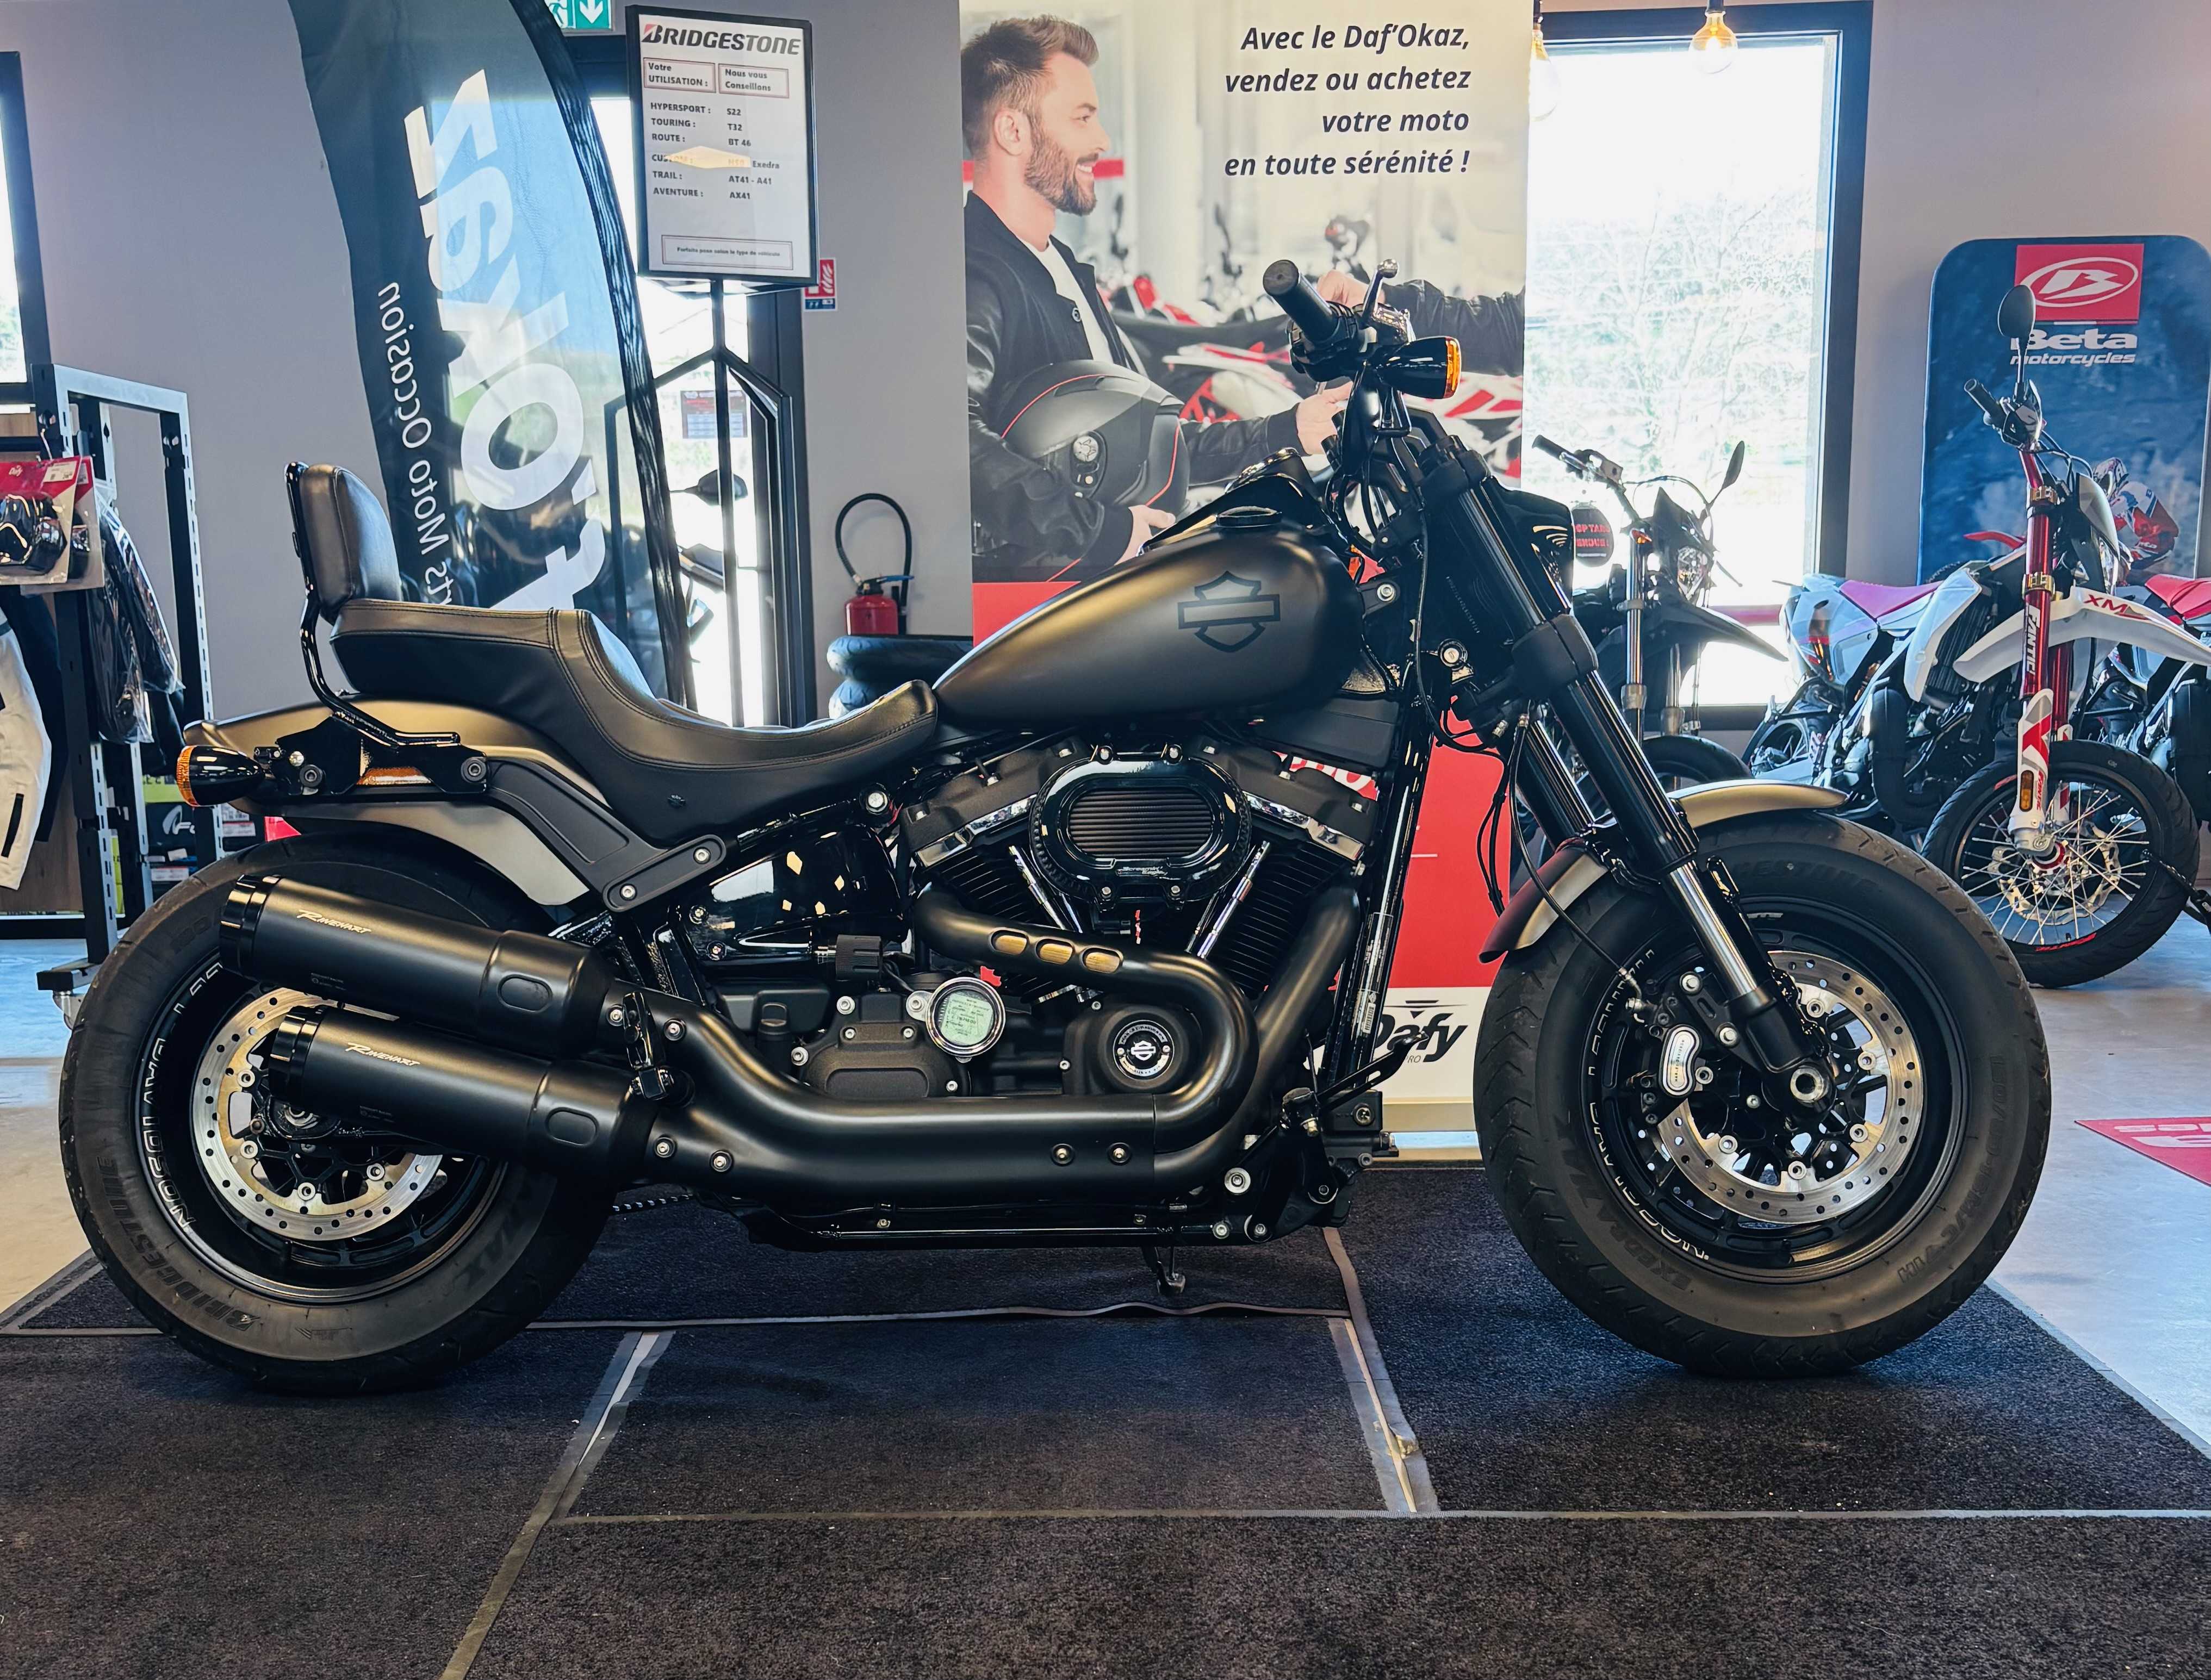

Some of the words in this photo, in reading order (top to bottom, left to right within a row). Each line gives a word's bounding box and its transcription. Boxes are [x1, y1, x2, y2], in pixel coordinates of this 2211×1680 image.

[641, 24, 801, 55] BRIDGESTONE
[1240, 27, 1305, 50] Avec
[1312, 25, 1336, 49] le
[648, 63, 672, 71] Votre
[725, 69, 746, 78] Nous
[649, 75, 703, 86] UTILISATION
[1225, 67, 1318, 92] vendez
[1326, 72, 1358, 91] ou
[1367, 66, 1471, 91] achetez
[725, 81, 771, 91] Conseillons
[651, 103, 705, 114] HYPERSPORT
[651, 118, 691, 127] TOURING
[1322, 110, 1392, 133] votre
[1400, 109, 1469, 132] moto
[652, 133, 680, 142] ROUTE
[728, 138, 739, 146] BT
[753, 161, 780, 169] Exedra
[1225, 158, 1256, 177] en
[1265, 153, 1336, 176] toute
[1344, 150, 1453, 175] sérénité
[1461, 150, 1470, 173] !
[653, 171, 677, 179] TRAIL
[729, 175, 749, 184] AT41
[757, 177, 772, 185] A41
[653, 187, 698, 197] AVENTURE
[2010, 328, 2138, 351] Beta
[2010, 352, 2136, 367] motorcycles
[296, 909, 372, 934] RINEHART
[345, 1042, 420, 1067] RINEHART
[1406, 1055, 1421, 1063] RO
